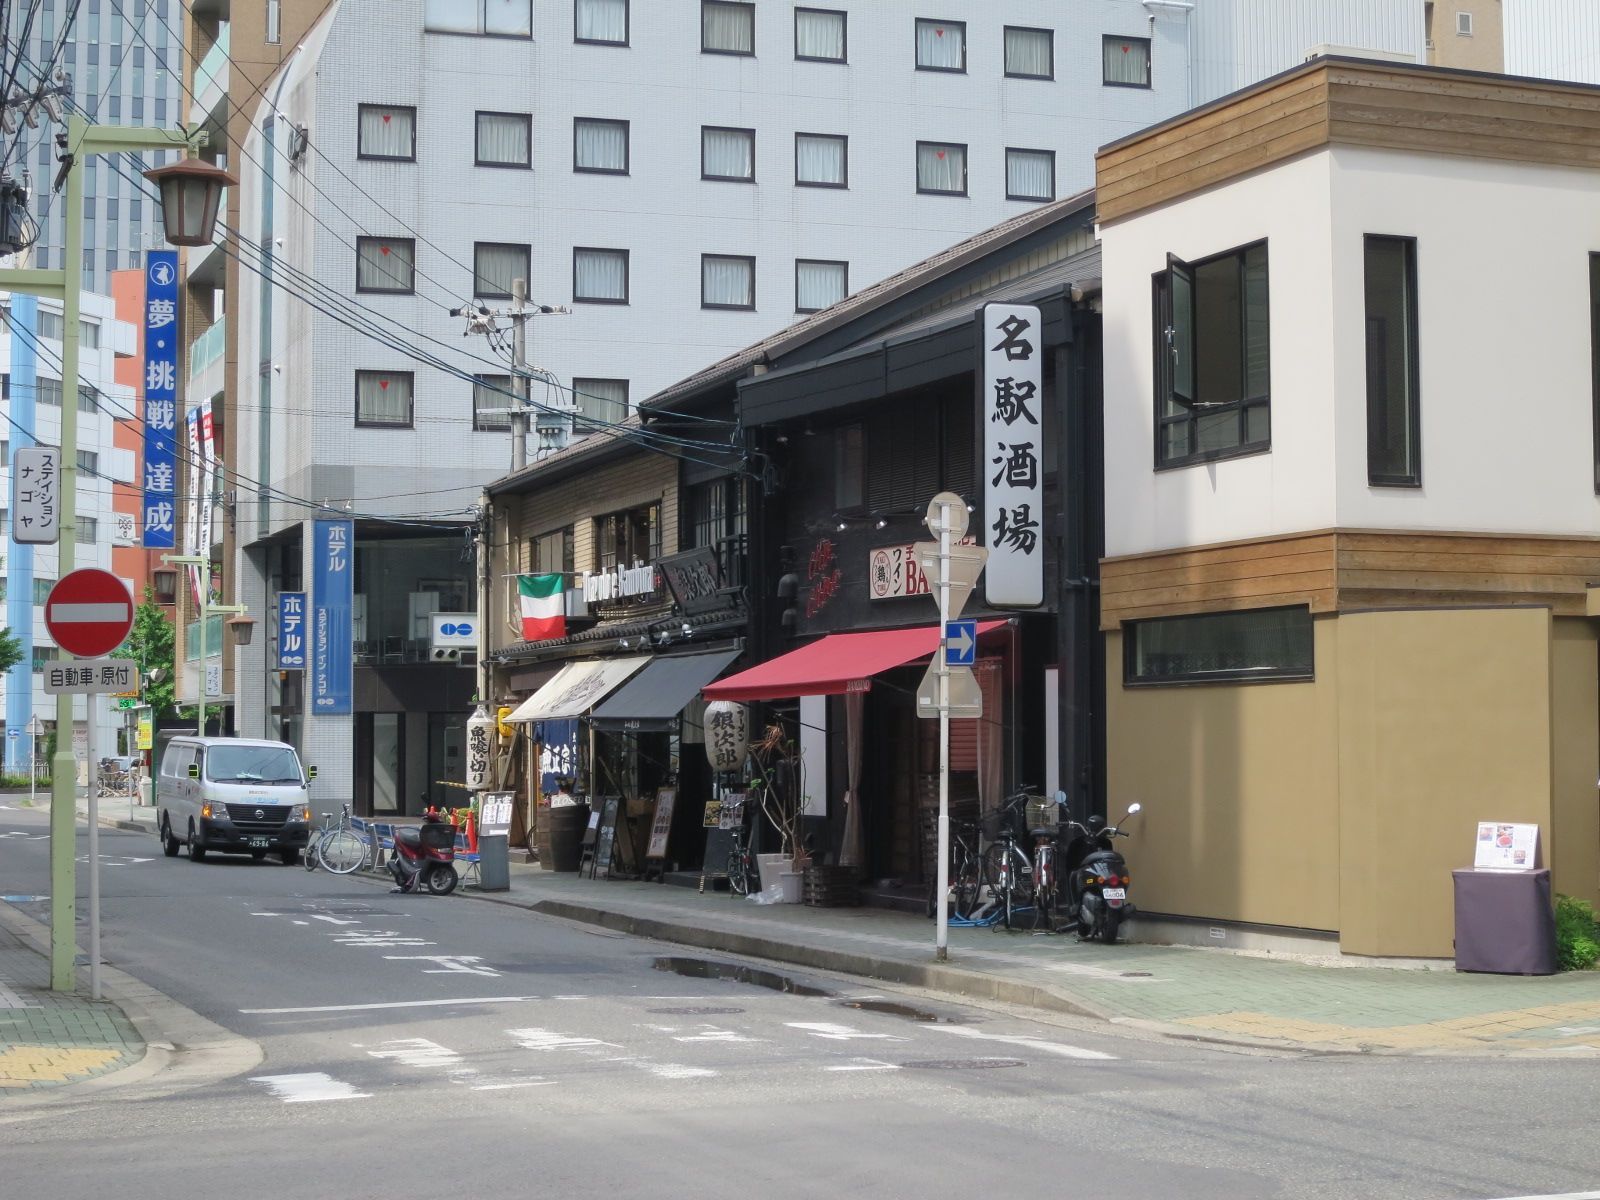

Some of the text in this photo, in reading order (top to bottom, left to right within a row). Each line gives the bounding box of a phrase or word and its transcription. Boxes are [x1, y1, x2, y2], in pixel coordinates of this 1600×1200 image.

[145, 299, 175, 533] 夢・挑戦・達成
[992, 314, 1039, 555] 名駅酒場
[20, 466, 34, 528] ナゴヤ
[40, 454, 54, 528] ステイション
[328, 525, 346, 572] ホテル
[892, 548, 902, 595] ワイン
[905, 560, 932, 595] BA
[284, 596, 302, 652] ホテル
[50, 666, 130, 687] 自動車・原付
[710, 710, 738, 767] 銀次郎
[736, 705, 745, 742] ラーメン
